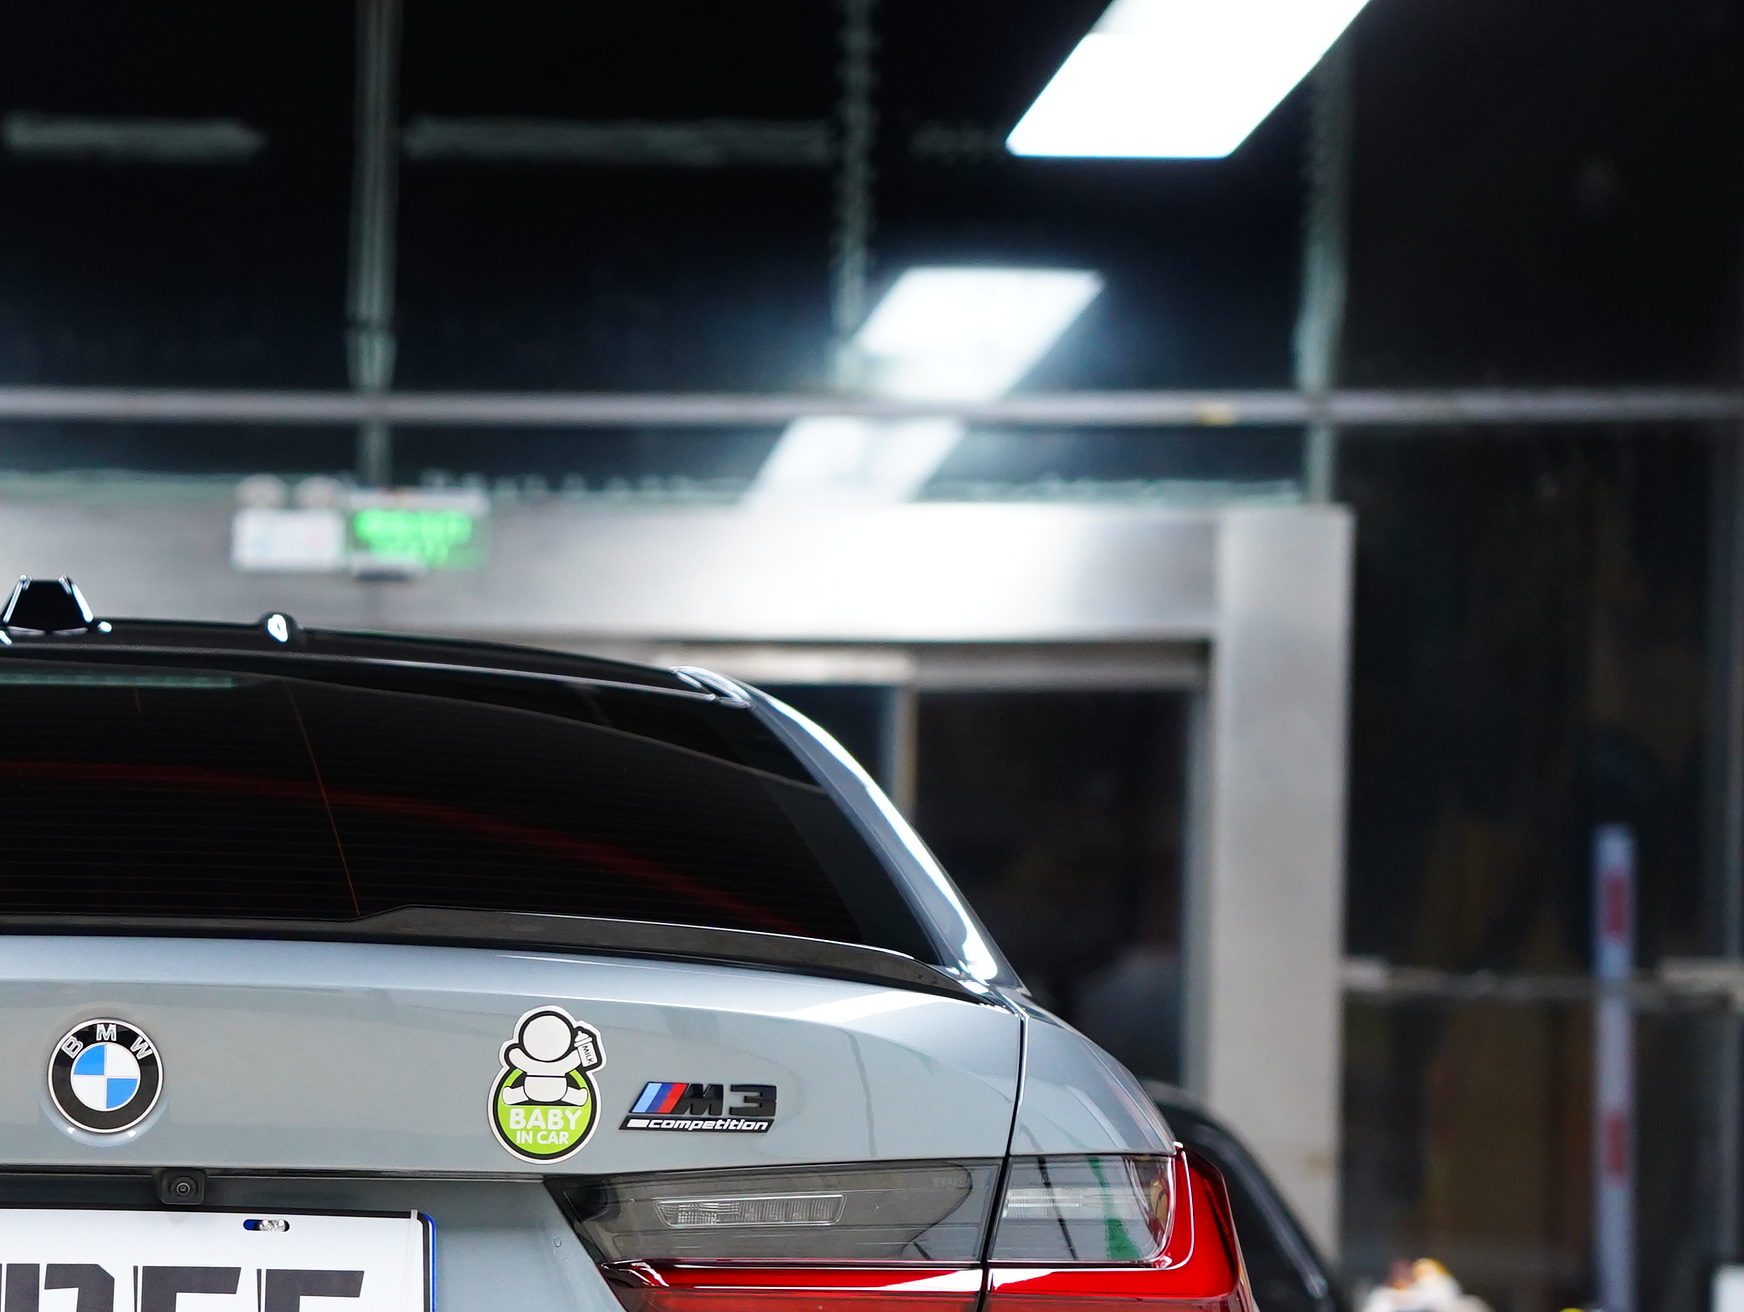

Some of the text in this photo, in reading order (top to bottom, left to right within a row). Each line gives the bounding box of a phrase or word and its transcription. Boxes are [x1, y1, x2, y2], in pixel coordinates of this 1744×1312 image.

[61, 1023, 153, 1060] BMW
[582, 1045, 594, 1065] MILK
[672, 1082, 777, 1117] M3
[509, 1108, 582, 1131] BABY
[647, 1118, 769, 1132] competition
[516, 1130, 569, 1145] IN CAR
